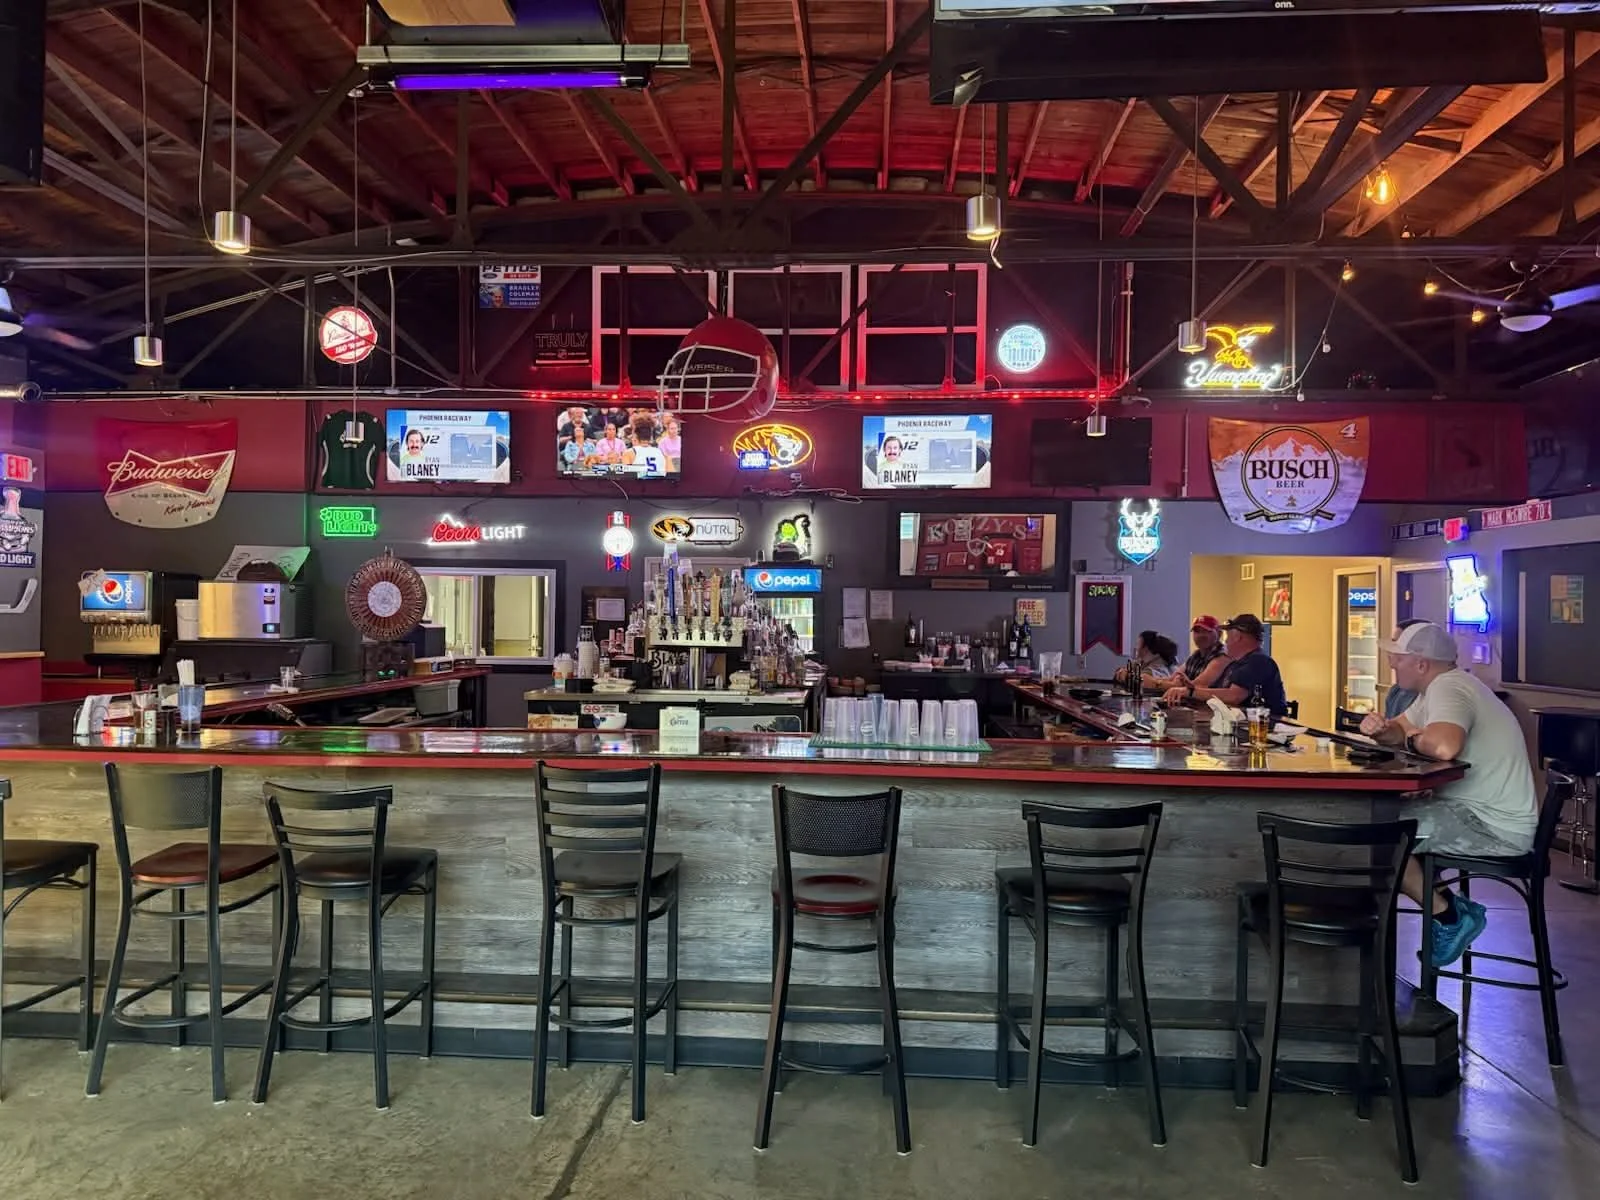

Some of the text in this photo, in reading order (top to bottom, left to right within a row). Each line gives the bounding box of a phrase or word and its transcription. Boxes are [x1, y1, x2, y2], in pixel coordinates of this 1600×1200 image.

[1274, 1, 1295, 9] onn.
[535, 332, 588, 349] TRULY
[1340, 423, 1358, 438] 4
[7, 456, 29, 478] EXIT
[406, 463, 440, 477] BLANEY
[645, 456, 657, 472] 5
[1250, 459, 1331, 480] BUSCH
[107, 461, 226, 482] Budweise
[883, 470, 918, 483] BLANEY
[1276, 480, 1305, 488] BEER
[332, 510, 363, 520] BUD
[326, 520, 369, 532] LIGHT
[433, 523, 527, 542] Coors LIGHT
[8, 554, 33, 564] LIGHT
[774, 575, 811, 587] pepsi
[124, 580, 134, 604] pepsi
[1348, 590, 1377, 602] pepsi
[1018, 601, 1036, 609] FREE
